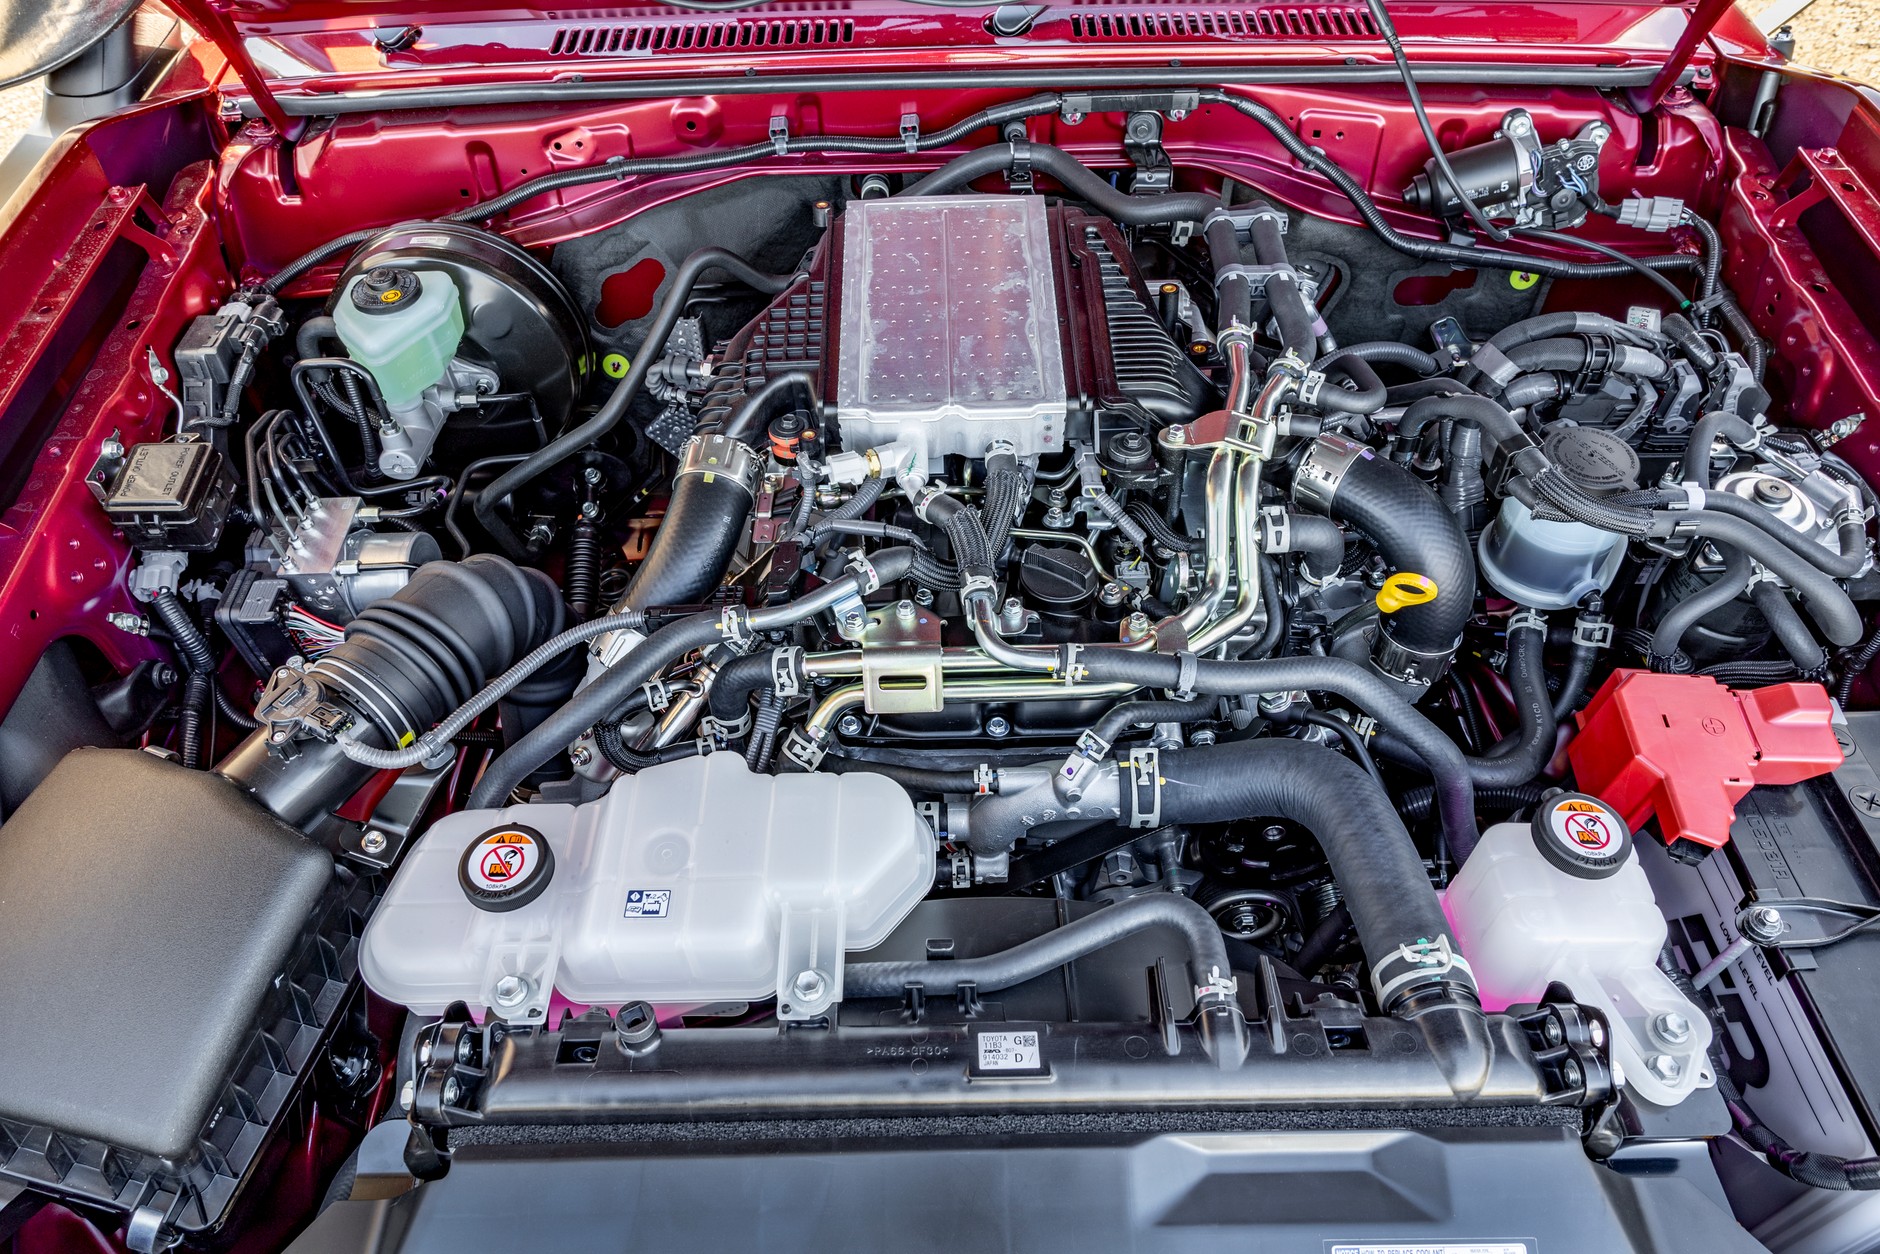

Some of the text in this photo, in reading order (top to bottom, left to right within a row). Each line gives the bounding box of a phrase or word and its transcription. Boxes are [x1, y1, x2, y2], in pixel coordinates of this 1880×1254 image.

[1500, 181, 1509, 192] 5
[120, 448, 150, 497] POWER OUTLET
[162, 447, 191, 496] POWER OUTLET
[1575, 854, 1617, 867] DENSO
[474, 888, 517, 899] DENSO
[1752, 946, 1772, 986] LEVEL
[1738, 961, 1758, 1001] LEVEL
[1013, 1035, 1022, 1045] G
[1014, 1053, 1023, 1063] D
